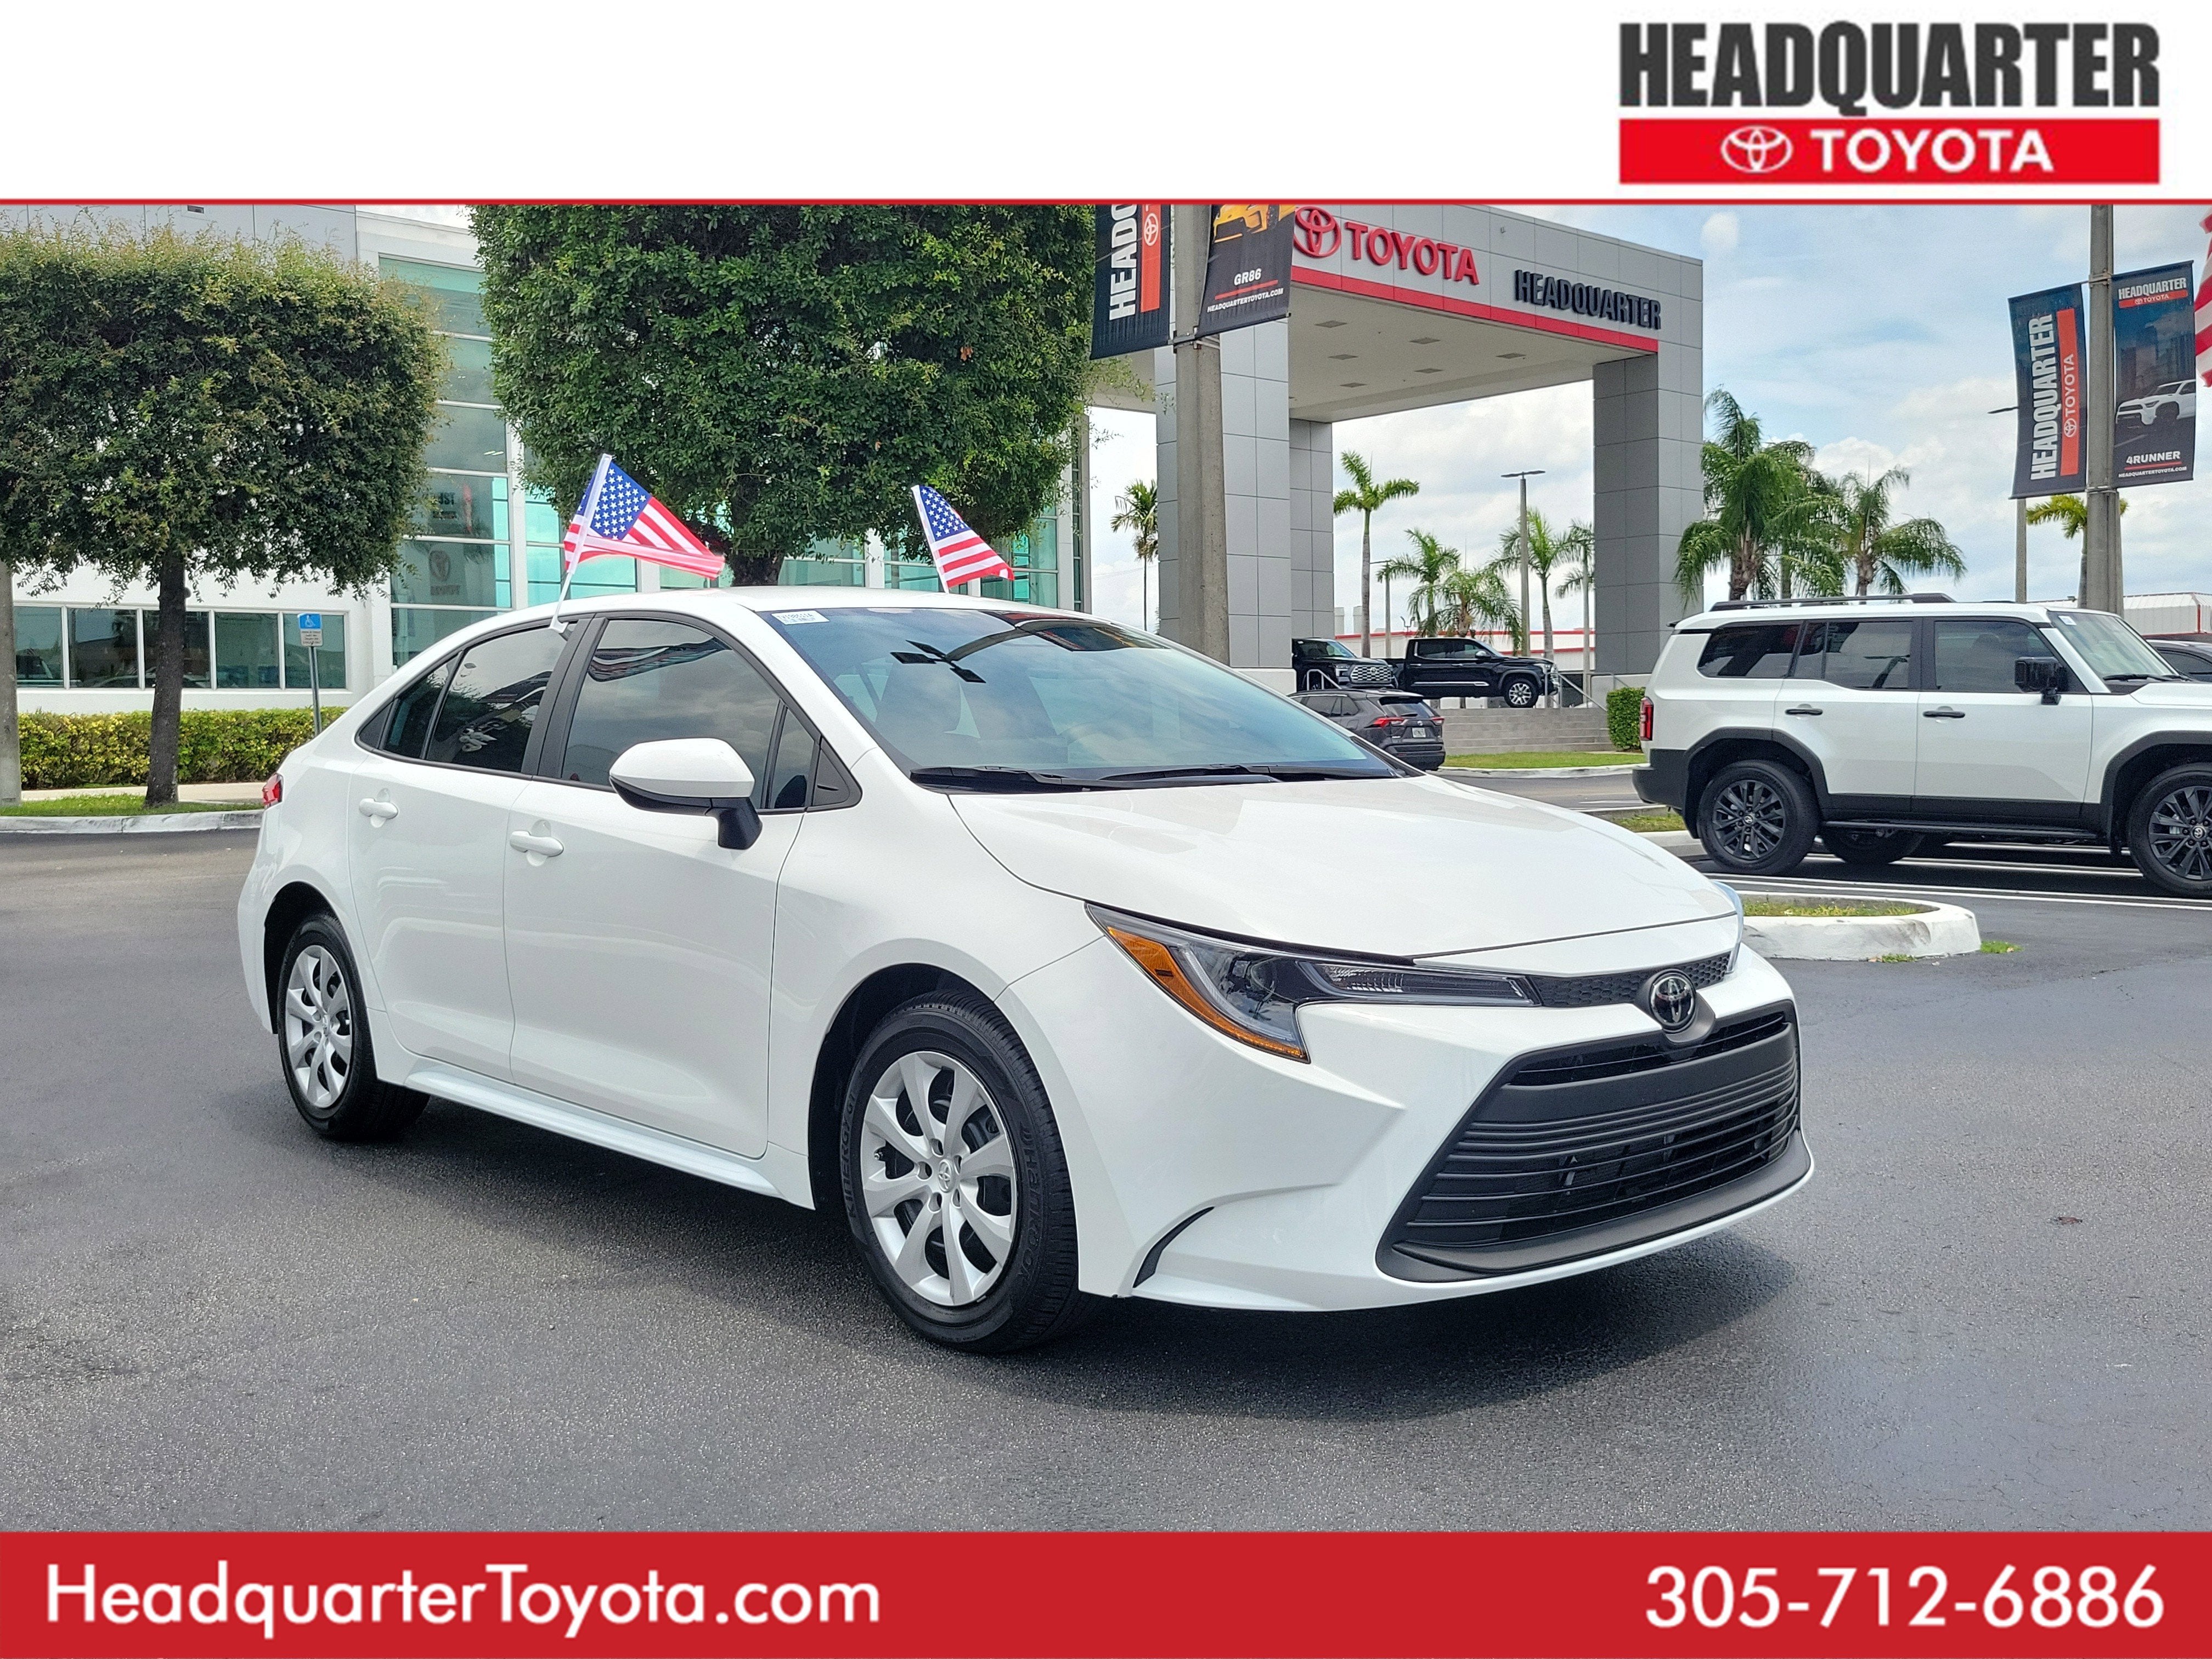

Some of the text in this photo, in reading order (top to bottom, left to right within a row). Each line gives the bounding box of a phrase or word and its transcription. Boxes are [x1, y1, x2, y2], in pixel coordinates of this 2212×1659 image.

[1345, 221, 1480, 285] TOYOTA
[1234, 268, 1262, 285] GR86
[2118, 277, 2187, 300] HEADQUARTER
[1207, 287, 1284, 313] HEADQUARTERTOYOTA.COM
[1515, 269, 1661, 329] HEADQUARTER
[2142, 294, 2169, 303] TOYOTA
[2029, 314, 2061, 480] HEADQUARTER
[2063, 354, 2075, 417] TOYOTA
[2126, 451, 2181, 465] 4RUNNER
[2118, 466, 2187, 478] HEADQUARTERTOYOTA.COM
